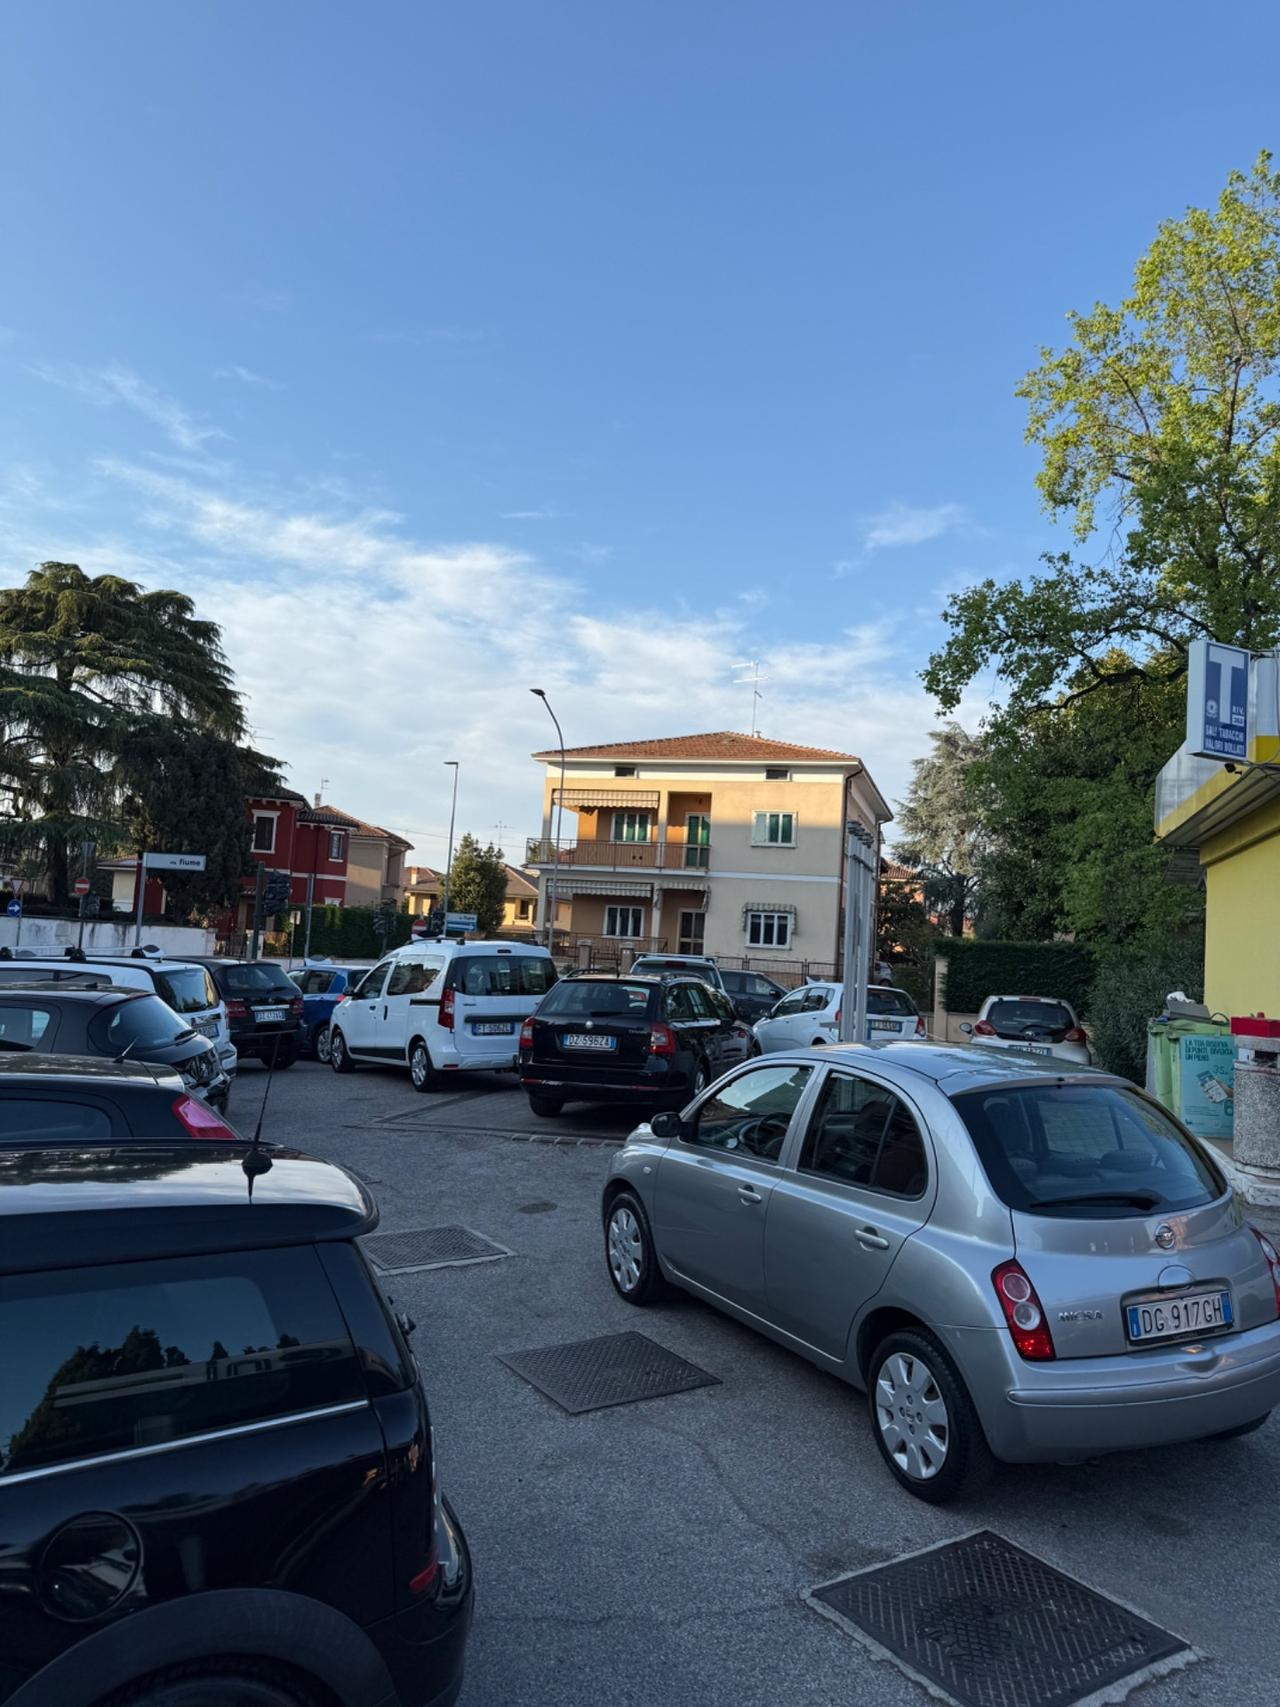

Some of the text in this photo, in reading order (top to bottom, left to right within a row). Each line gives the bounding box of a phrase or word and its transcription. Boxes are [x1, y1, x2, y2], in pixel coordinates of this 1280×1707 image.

[1209, 646, 1245, 725] T
[1223, 742, 1245, 756] BOLLATI
[179, 858, 201, 866] fiume
[1057, 1309, 1104, 1323] MICRA
[1141, 1297, 1223, 1334] DG 917GH
